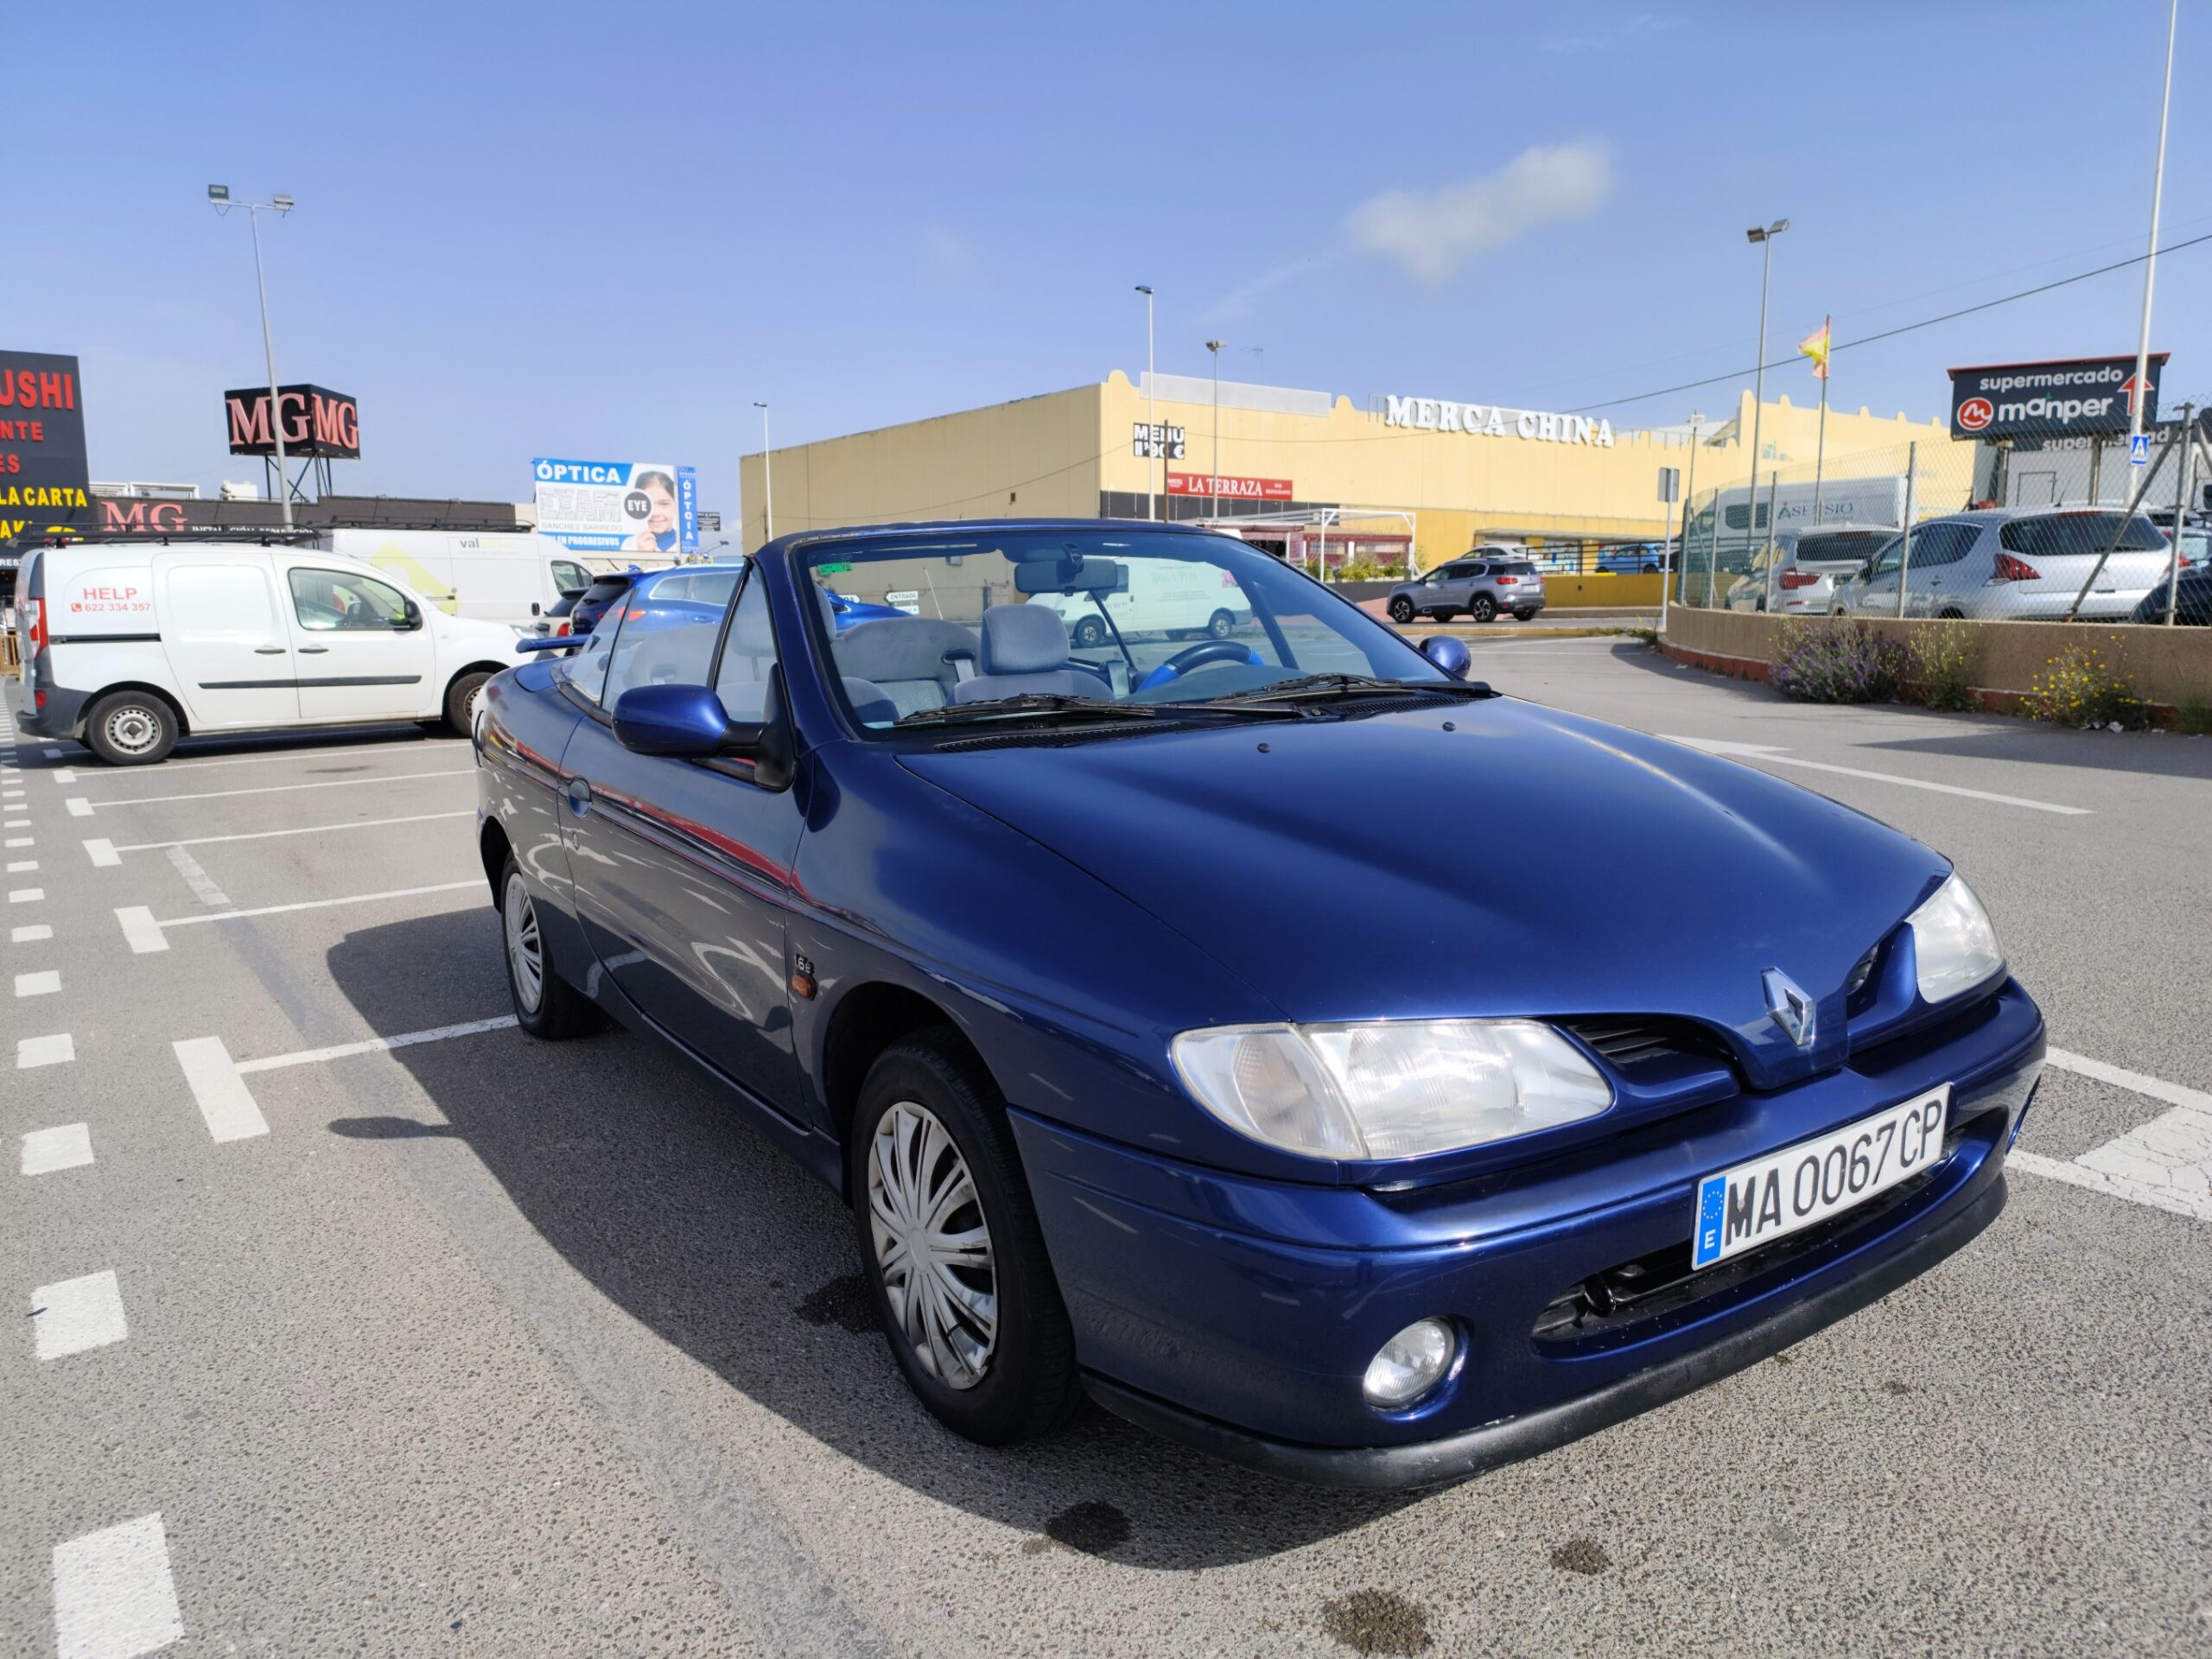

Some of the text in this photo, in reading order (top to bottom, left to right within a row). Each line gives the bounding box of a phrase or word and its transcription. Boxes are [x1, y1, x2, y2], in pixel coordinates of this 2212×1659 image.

[0, 369, 74, 410] USHI
[1980, 366, 2123, 393] supermercado
[226, 392, 311, 445] MG
[312, 392, 359, 449] MG
[1384, 394, 1615, 448] MERCA CHINA
[1999, 397, 2113, 424] manper
[537, 460, 621, 484] ÓPTICA
[23, 487, 87, 508] CARTA
[1188, 476, 1263, 497] LA TERRAZA
[100, 501, 188, 532] MG
[627, 499, 647, 512] EYE
[568, 536, 620, 547] PROGRESIVOS
[0, 558, 22, 567] RES
[83, 588, 137, 600] HELP
[85, 602, 151, 612] 622 334 357
[1726, 1099, 1942, 1247] MA 0067 CP
[1704, 1229, 1716, 1249] E
